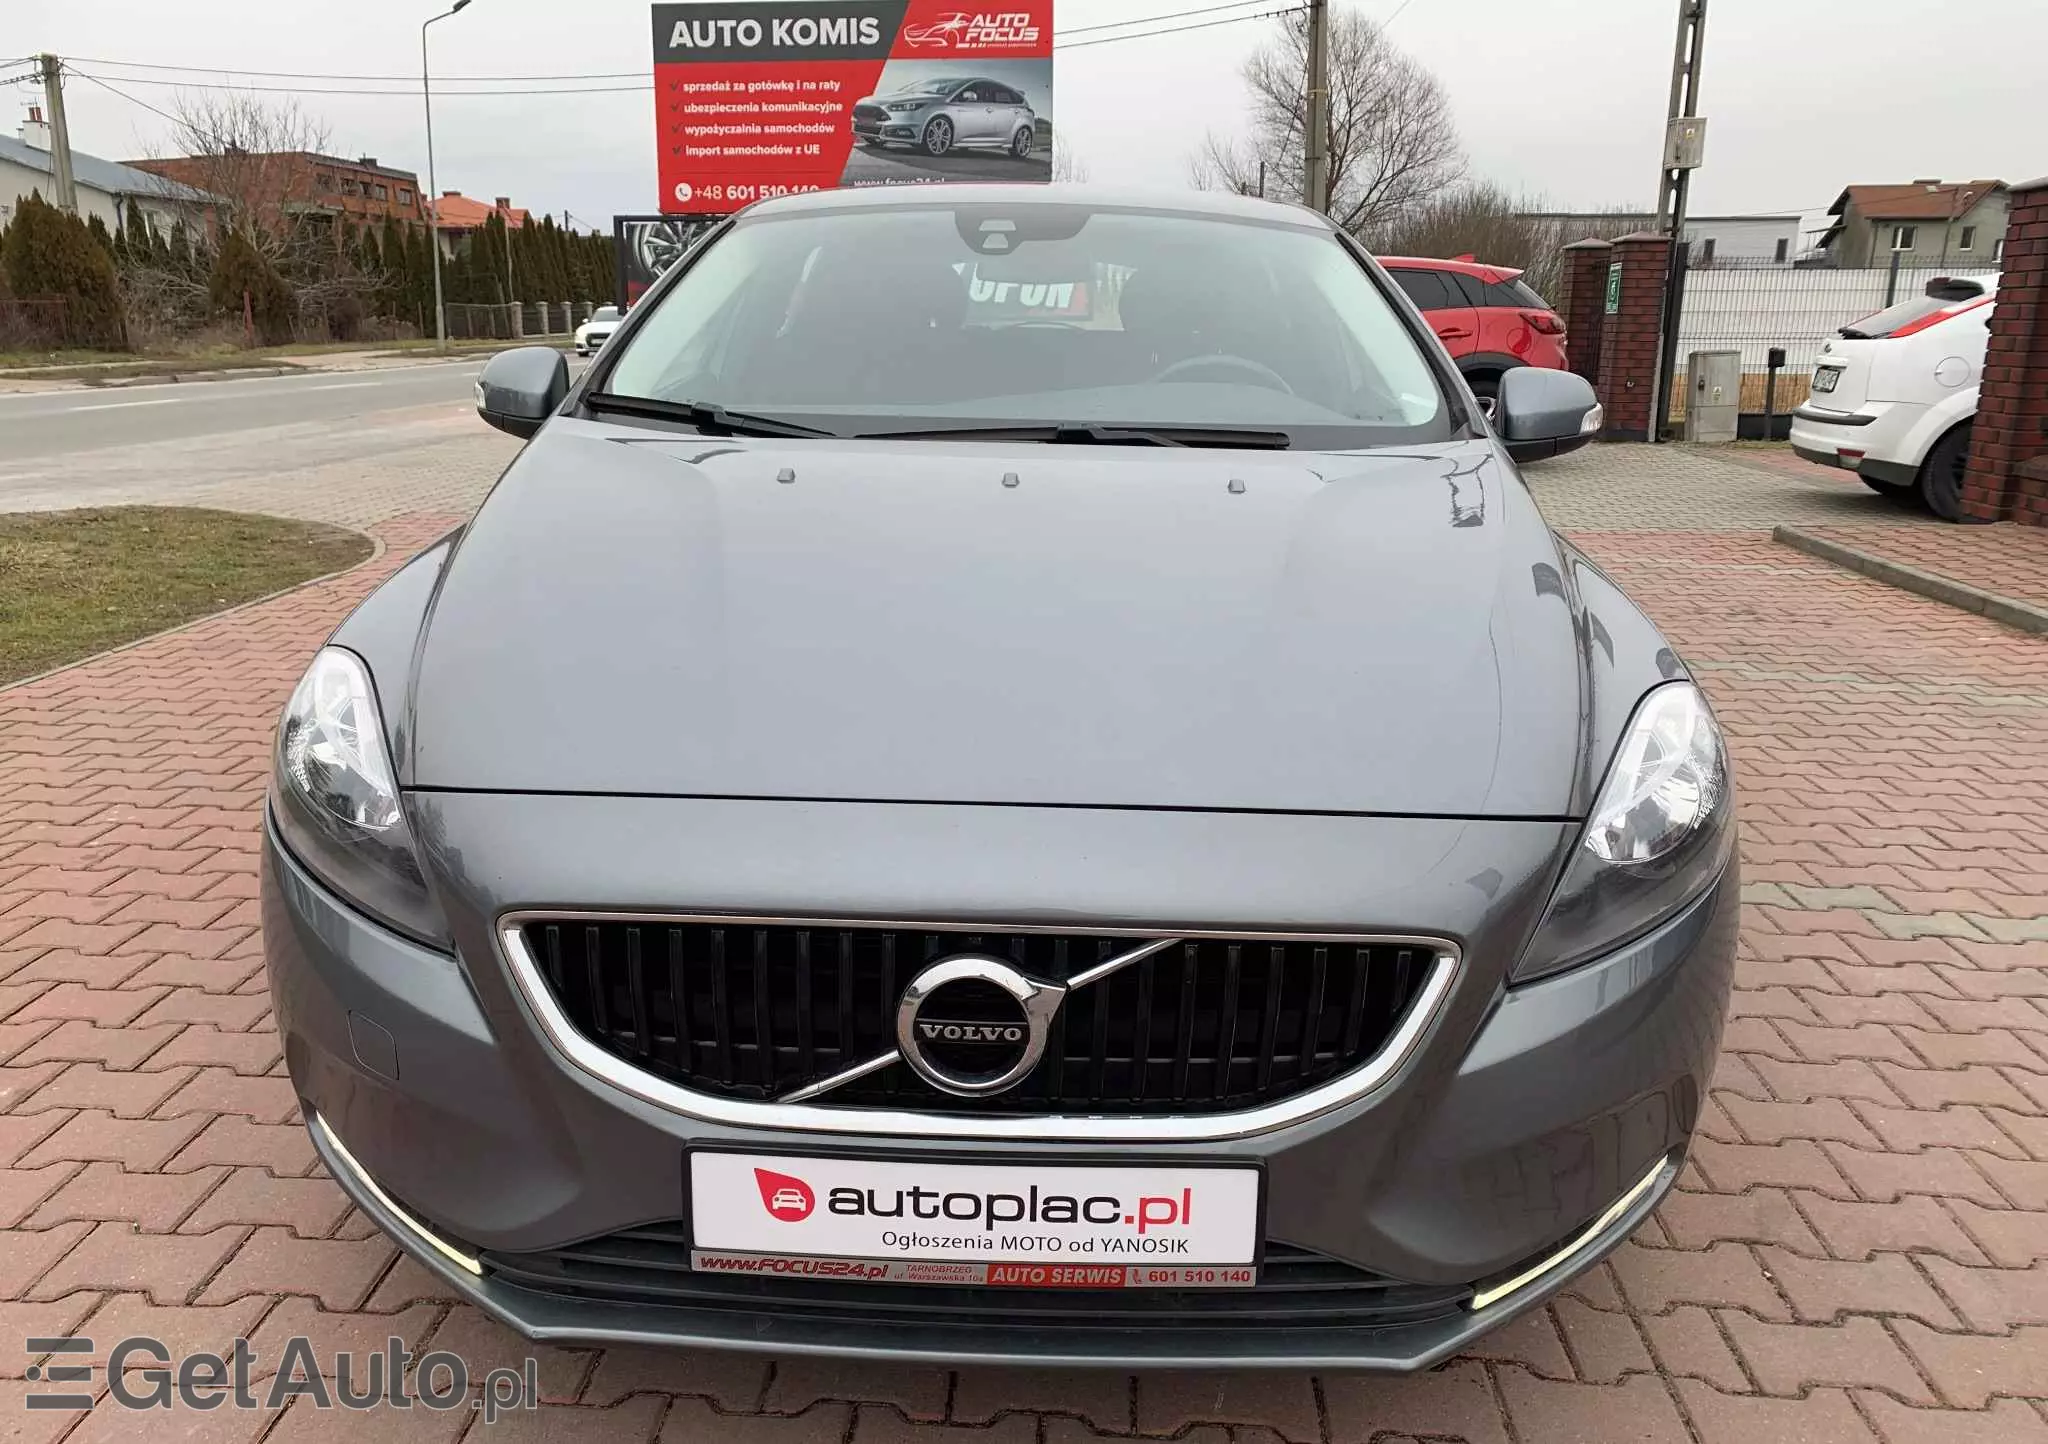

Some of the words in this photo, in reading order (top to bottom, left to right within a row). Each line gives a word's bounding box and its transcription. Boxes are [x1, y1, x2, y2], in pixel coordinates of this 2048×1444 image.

[969, 13, 1030, 27] AUTO
[669, 19, 763, 48] AUTO
[773, 17, 880, 46] KOMIS
[965, 27, 1039, 41] FOCUS
[683, 81, 731, 94] sprzedaż
[733, 83, 745, 91] za
[748, 81, 794, 93] gotówkę
[803, 82, 816, 90] na
[819, 80, 840, 92] raty
[684, 103, 759, 114] ubezpieczenia
[762, 101, 843, 114] komunikacyjne
[685, 123, 761, 136] wypożyczalnia
[764, 123, 835, 133] samochodów
[723, 145, 793, 155] samochodów
[804, 144, 820, 154] UE
[695, 185, 722, 199] +48
[727, 185, 754, 199] 601
[760, 185, 787, 199] 510
[920, 1024, 1022, 1041] VOLVO
[828, 1184, 1192, 1234] autoplac.pl
[881, 1230, 994, 1252] Ogłoszenia
[1001, 1236, 1062, 1252] MOTO
[1069, 1237, 1095, 1253] od
[1100, 1238, 1189, 1254] YANOSIK
[700, 1257, 889, 1279] www.FOCUS24.pl
[906, 1264, 973, 1273] TARNOBRZEG
[991, 1267, 1046, 1283] AUTO
[1051, 1268, 1122, 1284] SERWIS
[1149, 1270, 1178, 1282] 601
[1184, 1271, 1214, 1282] 510
[1220, 1271, 1250, 1282] 140
